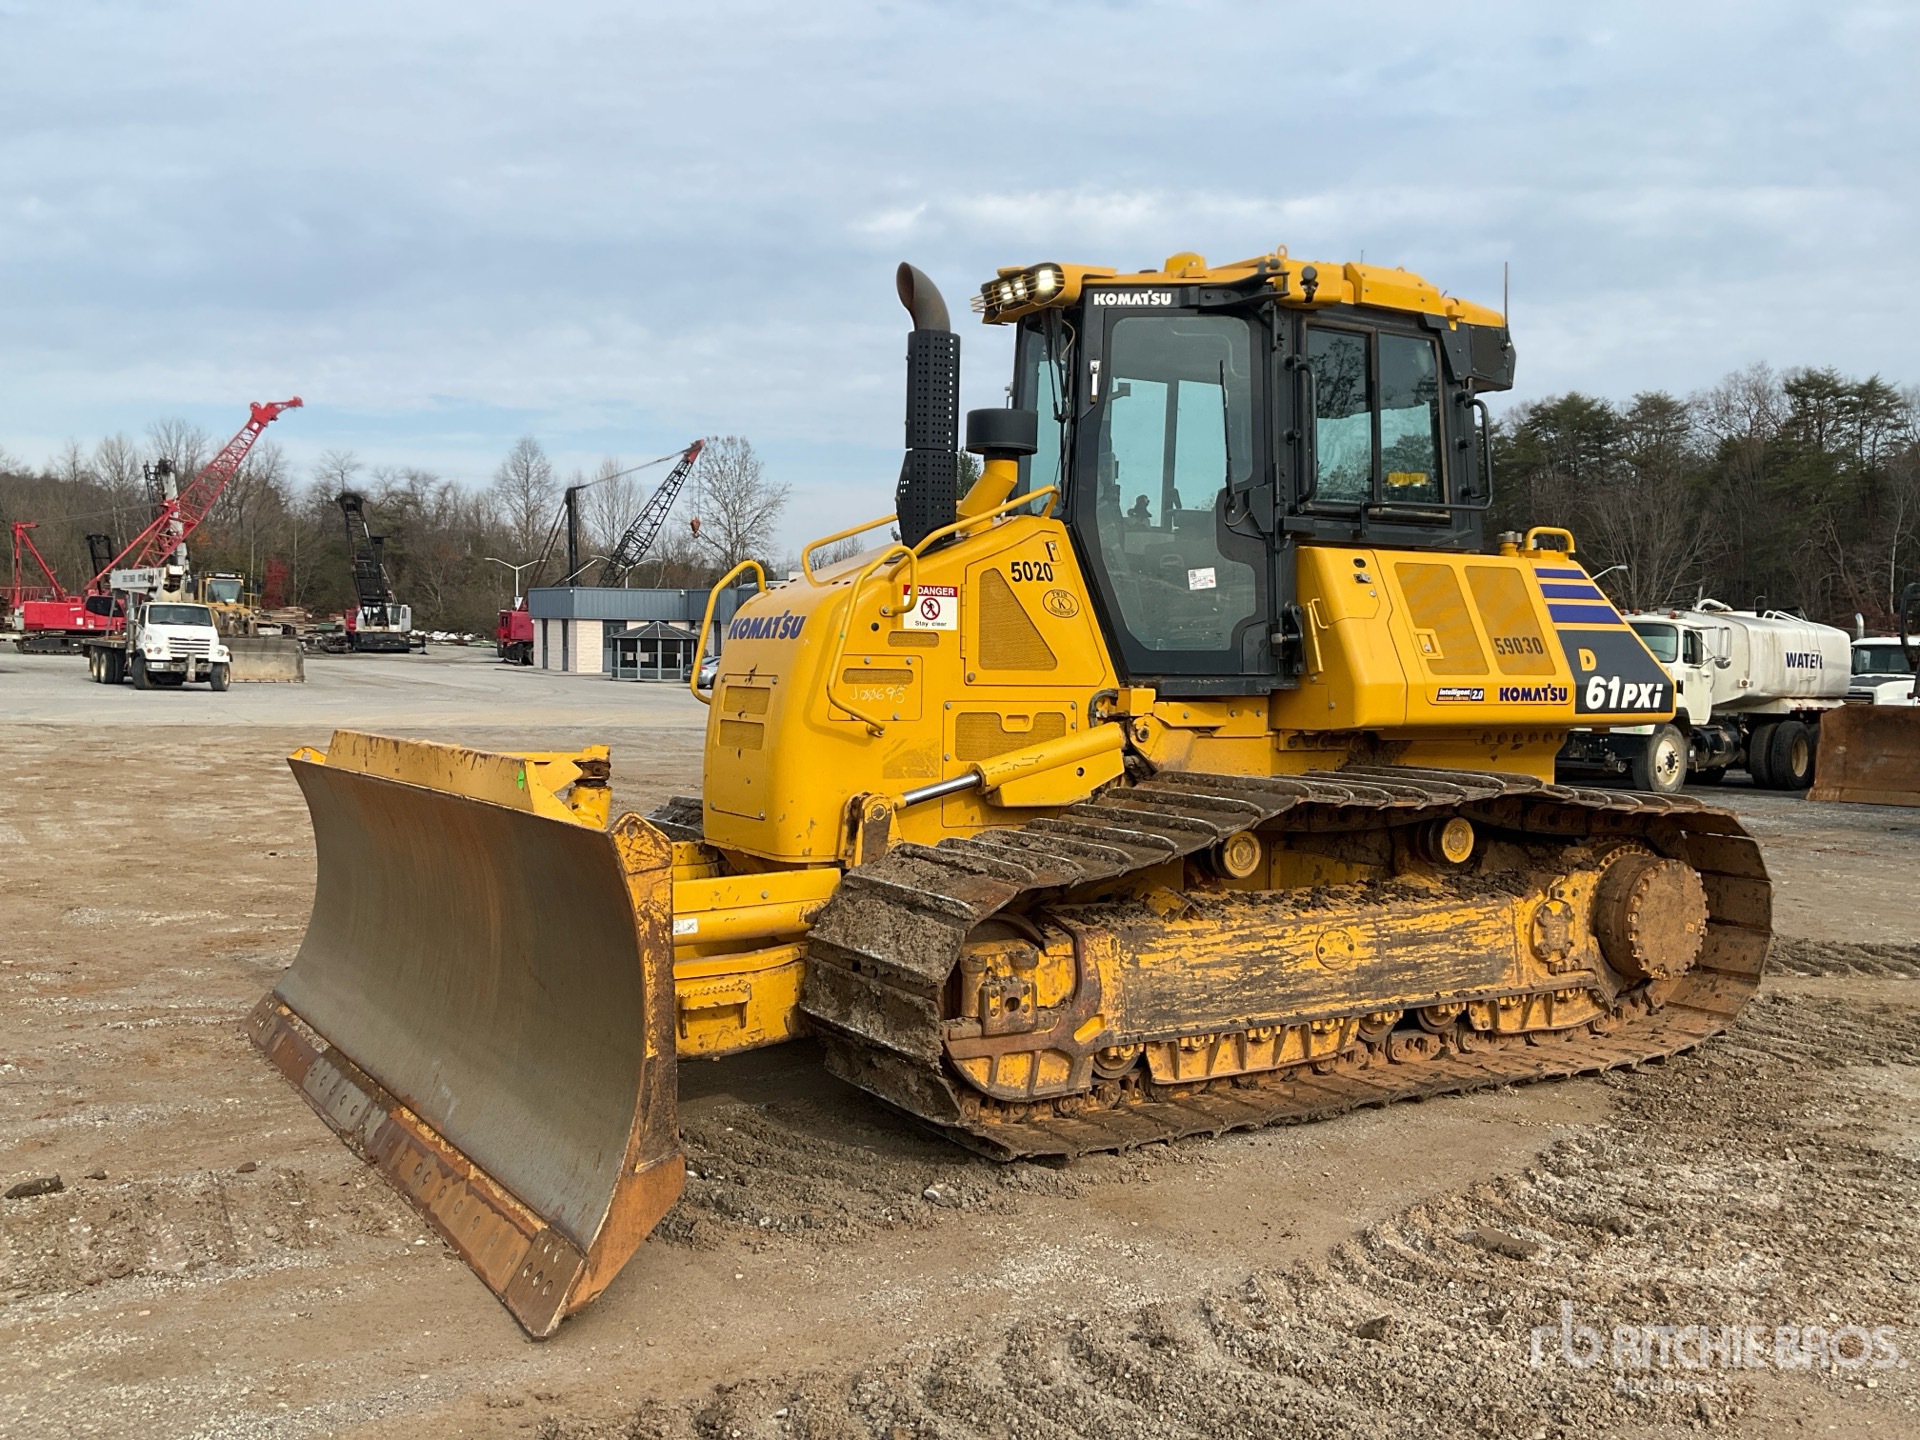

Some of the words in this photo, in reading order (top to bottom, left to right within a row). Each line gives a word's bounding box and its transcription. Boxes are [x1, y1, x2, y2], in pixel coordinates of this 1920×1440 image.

[1093, 290, 1172, 306] KOMATSU
[1010, 561, 1054, 582] 5020
[918, 586, 955, 596] DANGER
[727, 609, 807, 640] KOMATSU
[1493, 636, 1544, 655] 59030
[1578, 648, 1597, 671] D
[1499, 683, 1568, 702] KOMATSU
[1585, 675, 1664, 710] 61PXi
